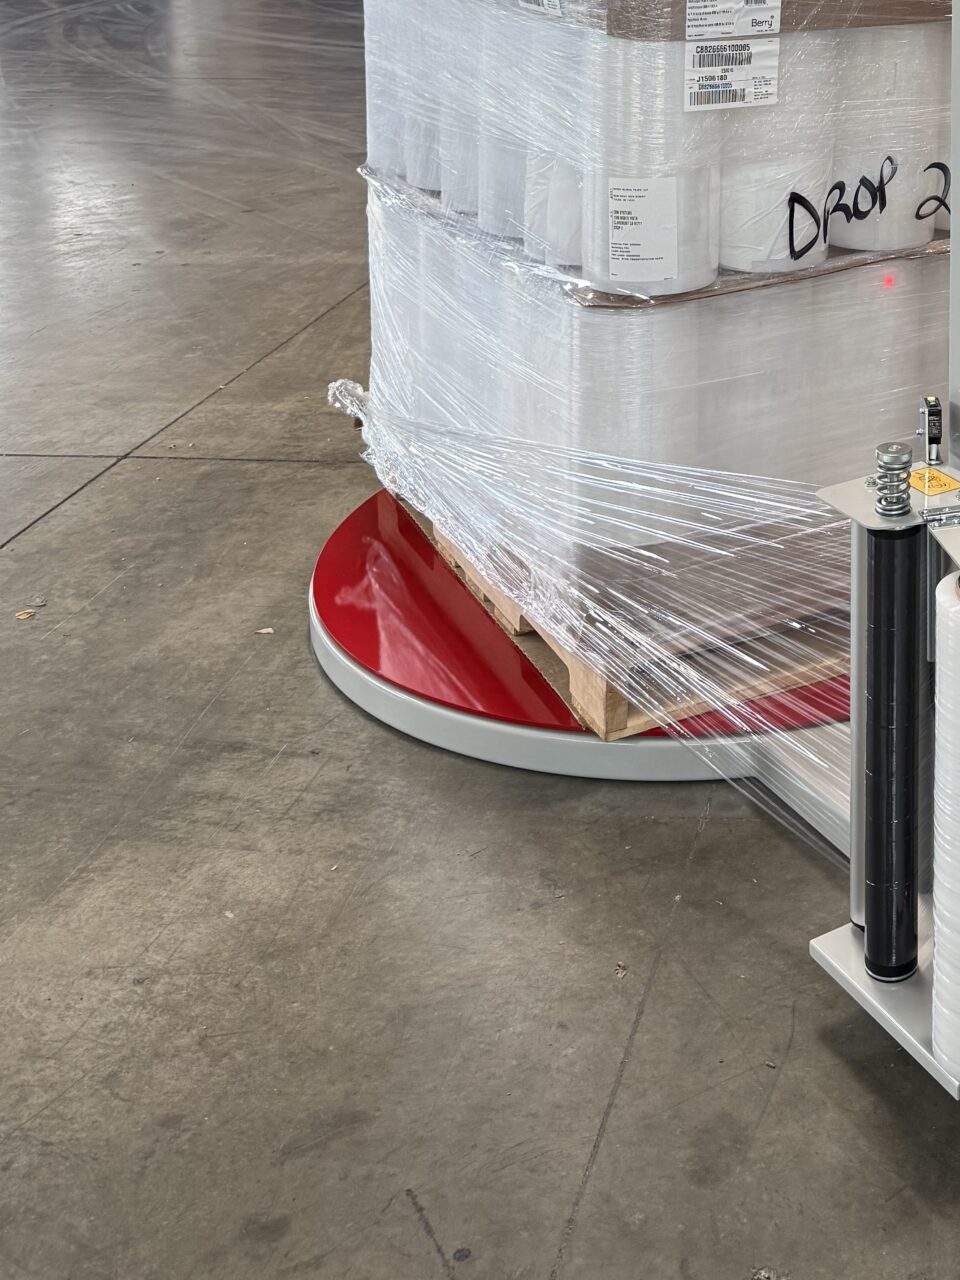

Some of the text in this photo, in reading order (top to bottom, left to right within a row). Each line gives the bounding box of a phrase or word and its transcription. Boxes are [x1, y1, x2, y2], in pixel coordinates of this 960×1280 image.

[751, 18, 773, 28] Berry
[788, 155, 951, 261] DROP 2
